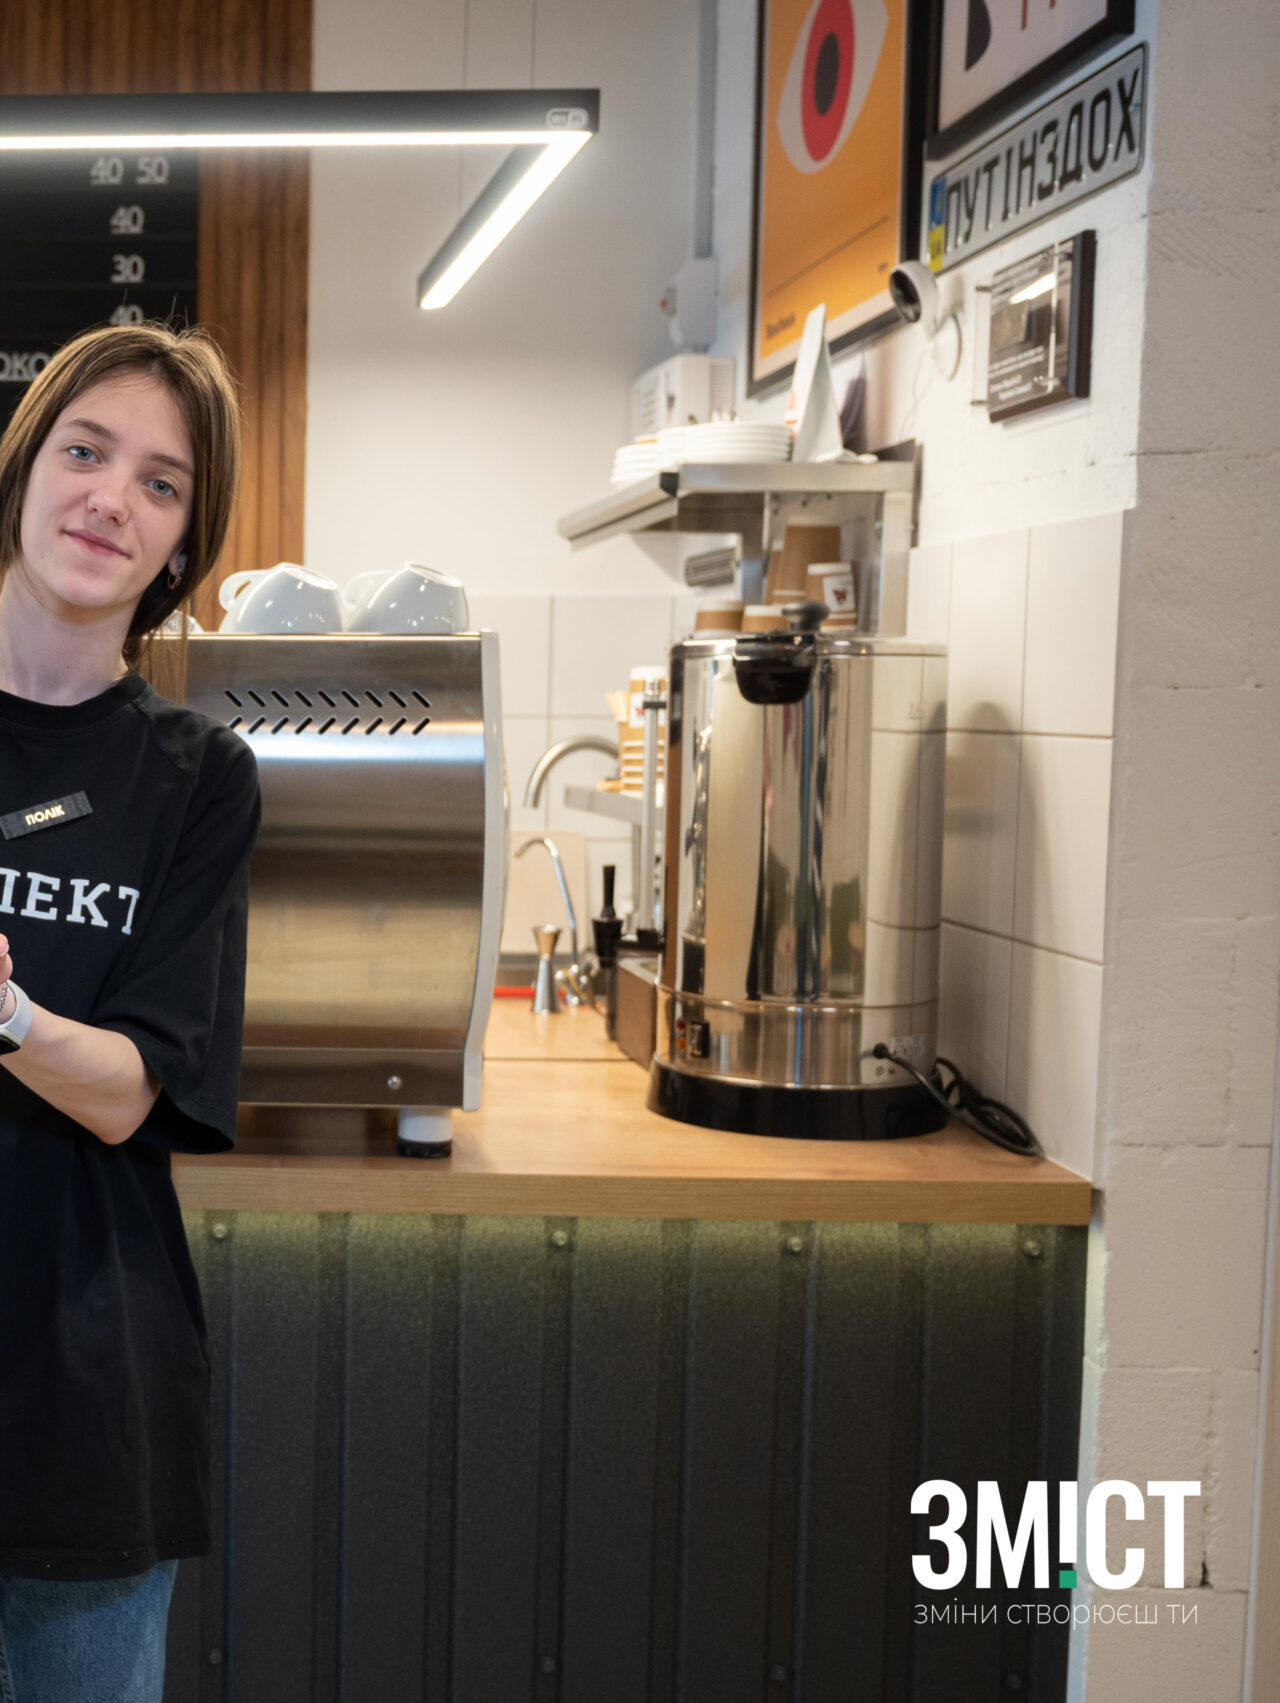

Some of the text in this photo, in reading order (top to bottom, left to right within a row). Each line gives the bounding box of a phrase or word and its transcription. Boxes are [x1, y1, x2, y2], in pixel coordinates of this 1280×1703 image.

[90, 156, 124, 185] 40
[136, 156, 169, 184] 50
[110, 205, 144, 234] 40
[111, 254, 145, 283] 30
[25, 804, 65, 826] ПОЛІК
